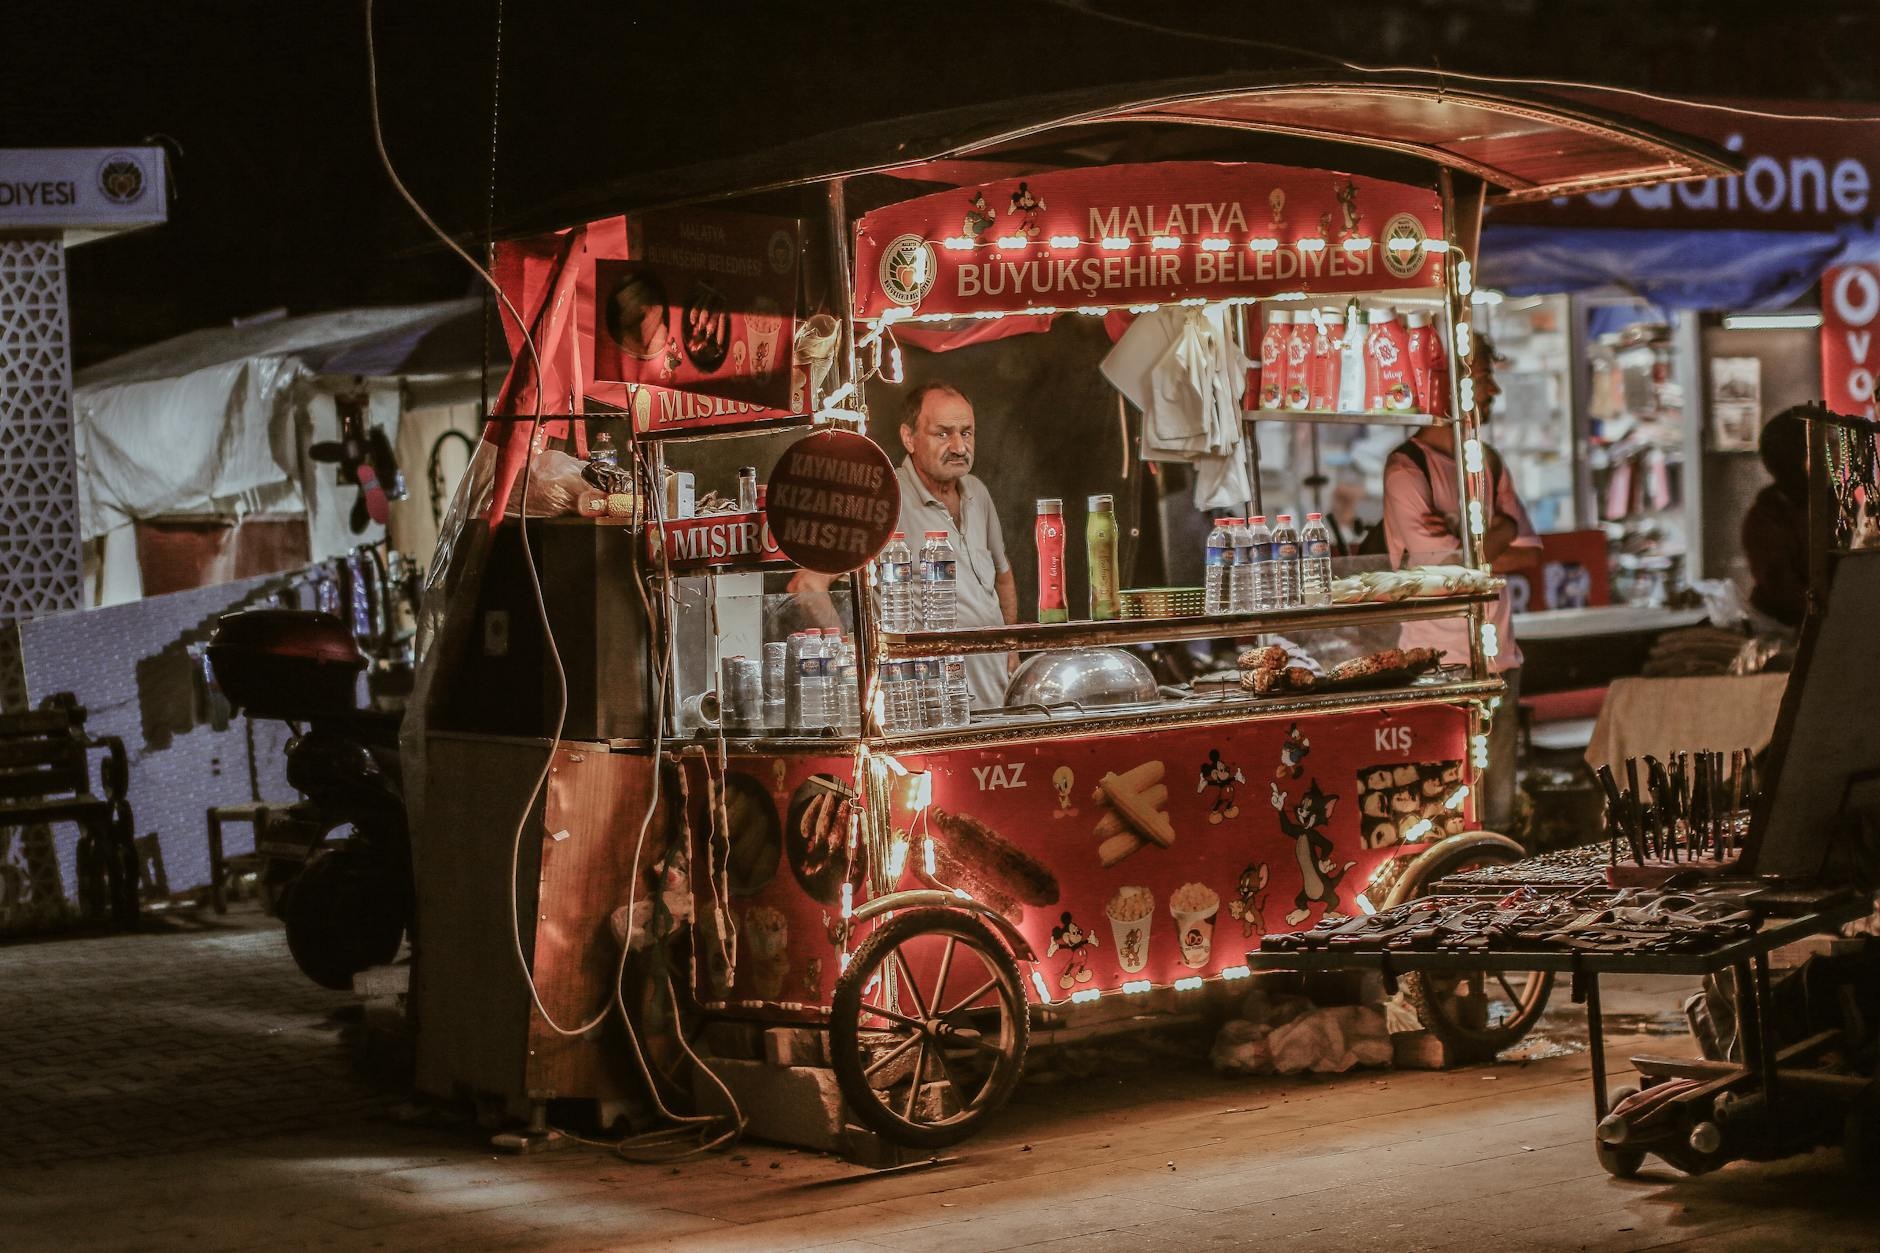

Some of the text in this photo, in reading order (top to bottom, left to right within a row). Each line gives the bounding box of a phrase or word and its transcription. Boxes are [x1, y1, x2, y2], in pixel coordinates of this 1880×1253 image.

[1089, 202, 1249, 239] MALATYA
[789, 452, 884, 495] KAYNAMIŞ
[774, 482, 890, 531] KIZARMIŞ
[782, 516, 869, 555] MISIR
[1374, 725, 1412, 757] KIŞ
[972, 762, 1026, 791] YAZ
